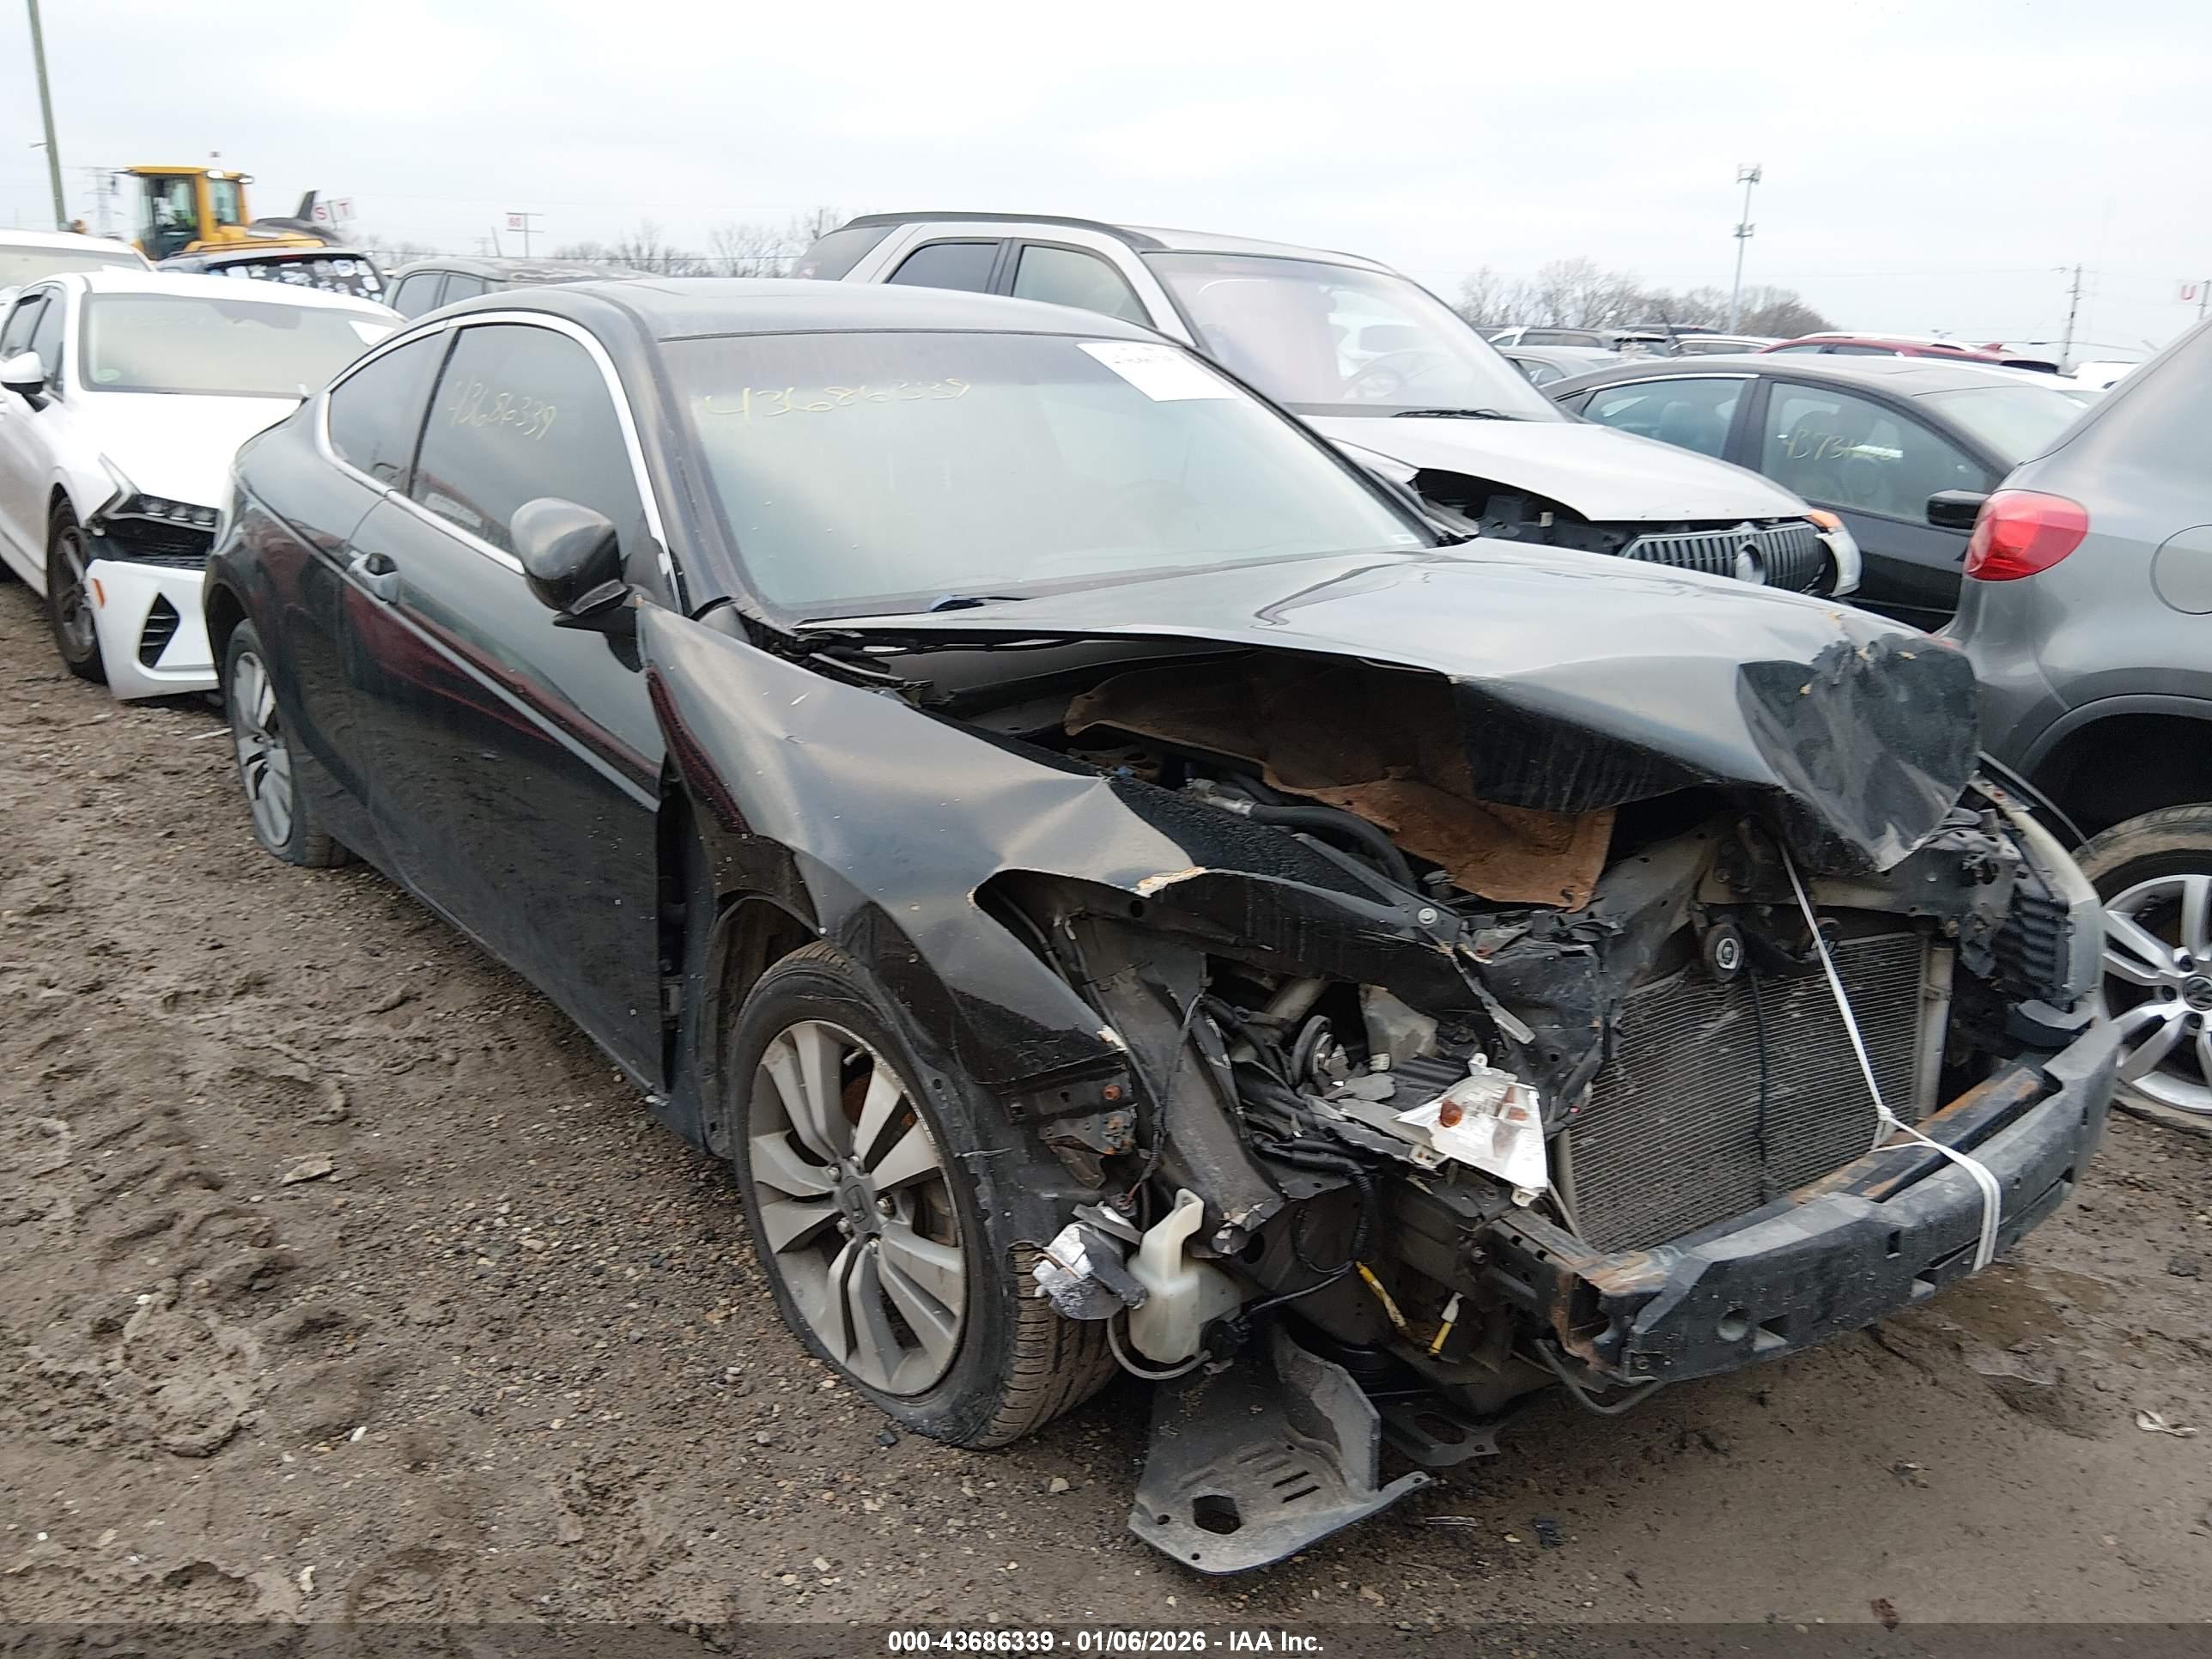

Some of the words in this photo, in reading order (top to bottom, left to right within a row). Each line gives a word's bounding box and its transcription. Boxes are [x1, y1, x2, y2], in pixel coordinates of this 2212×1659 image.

[314, 206, 327, 220] S
[2179, 284, 2197, 301] U
[702, 378, 972, 426] 43686339
